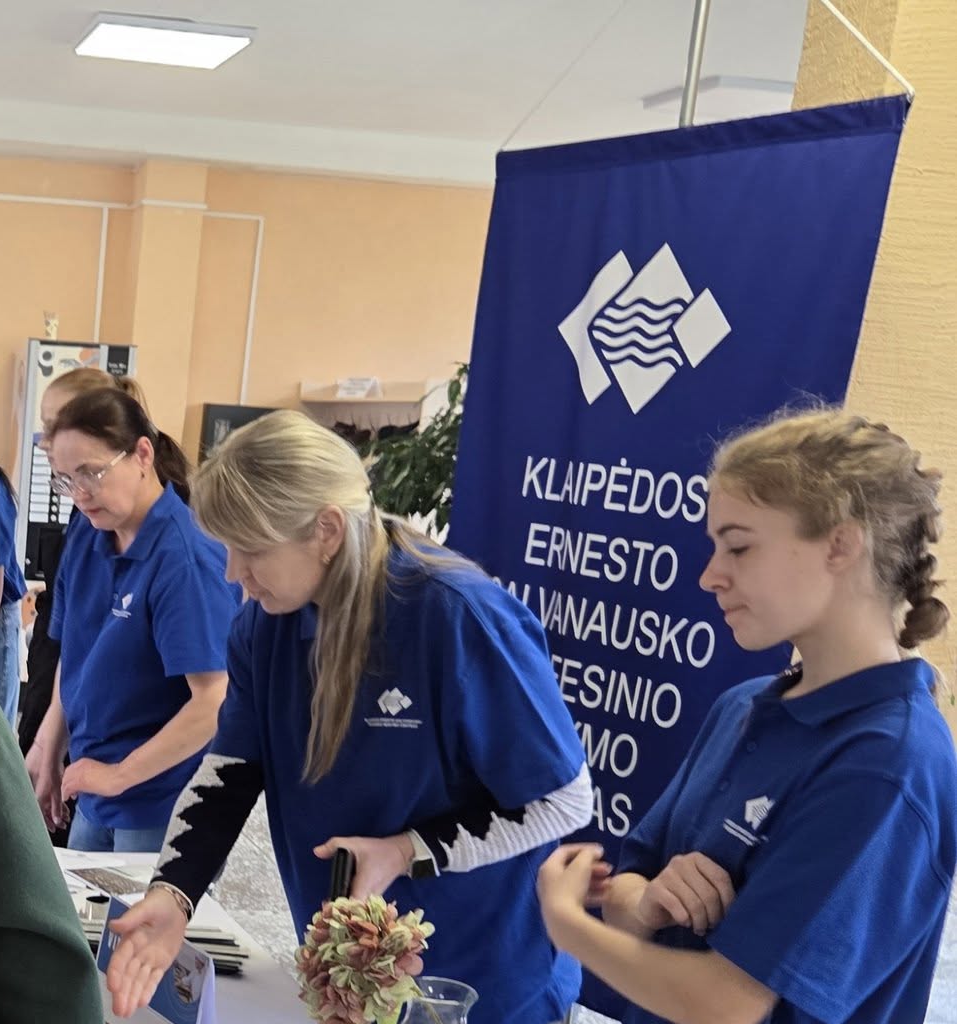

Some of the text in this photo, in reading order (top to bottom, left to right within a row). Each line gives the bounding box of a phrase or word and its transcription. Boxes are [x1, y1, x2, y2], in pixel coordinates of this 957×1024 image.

[521, 456, 709, 523] KLAIPĖDOS
[524, 522, 679, 592] ERNESTO
[493, 576, 716, 669] VANAUSKO
[551, 653, 682, 729] ESINIO
[573, 720, 638, 778] MO
